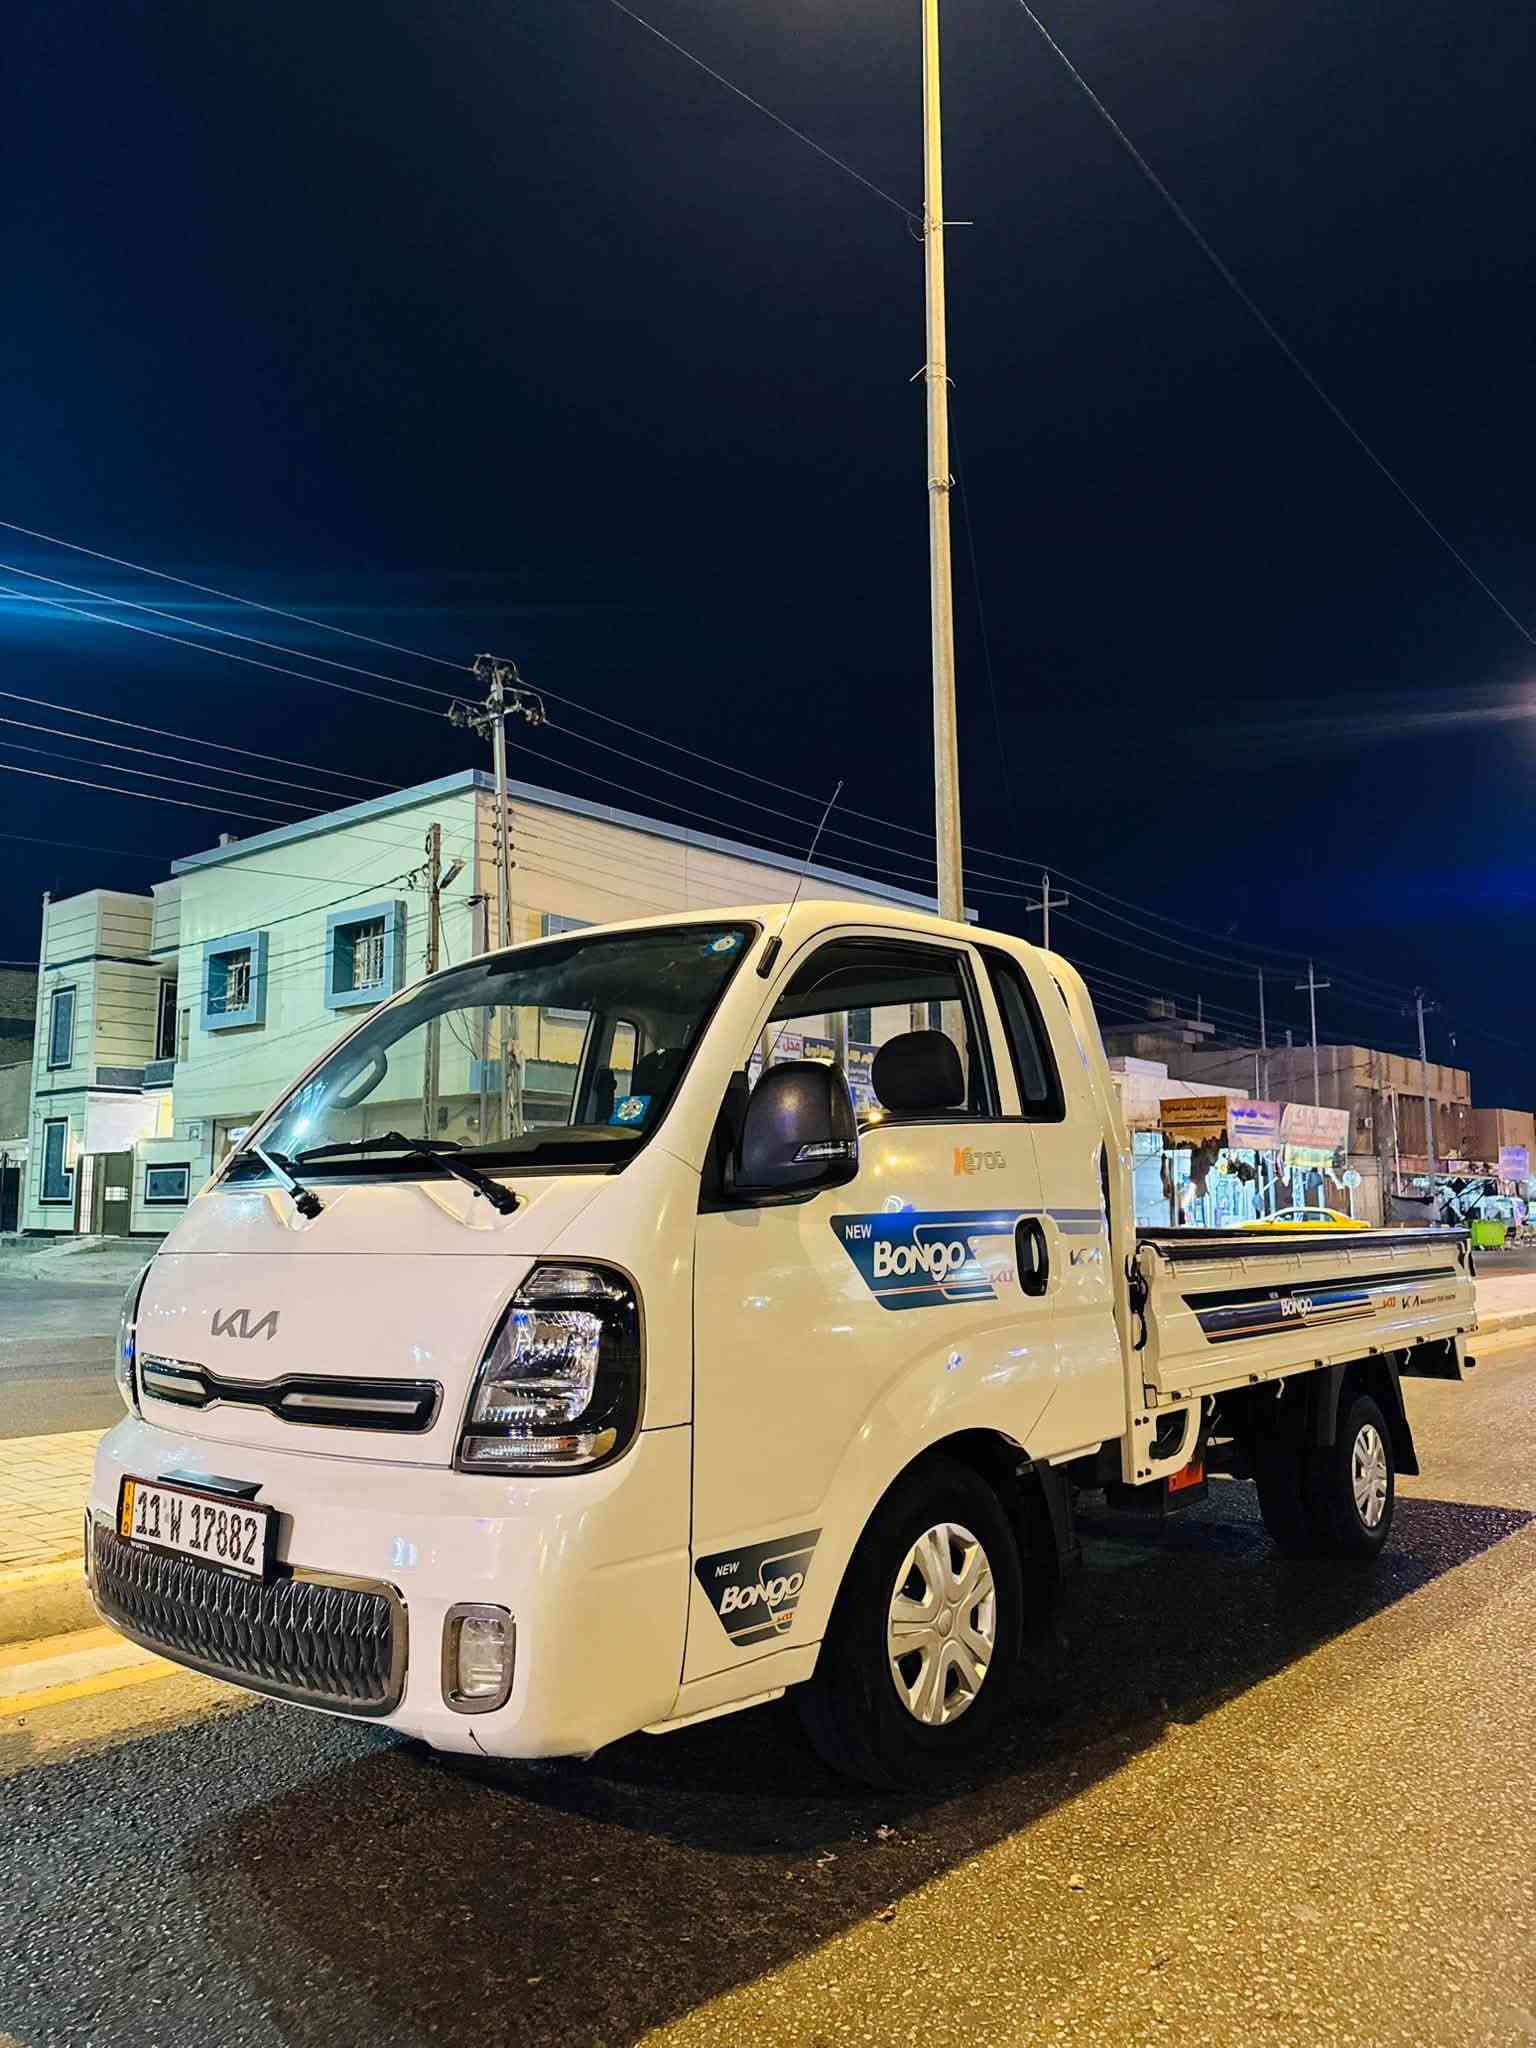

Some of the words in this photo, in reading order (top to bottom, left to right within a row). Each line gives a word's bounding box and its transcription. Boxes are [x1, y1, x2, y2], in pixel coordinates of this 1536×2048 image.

[845, 1224, 872, 1240] NEW
[211, 1308, 281, 1341] KIA
[136, 1491, 161, 1538] 11
[189, 1503, 257, 1565] 17882
[714, 1562, 740, 1579] NEW
